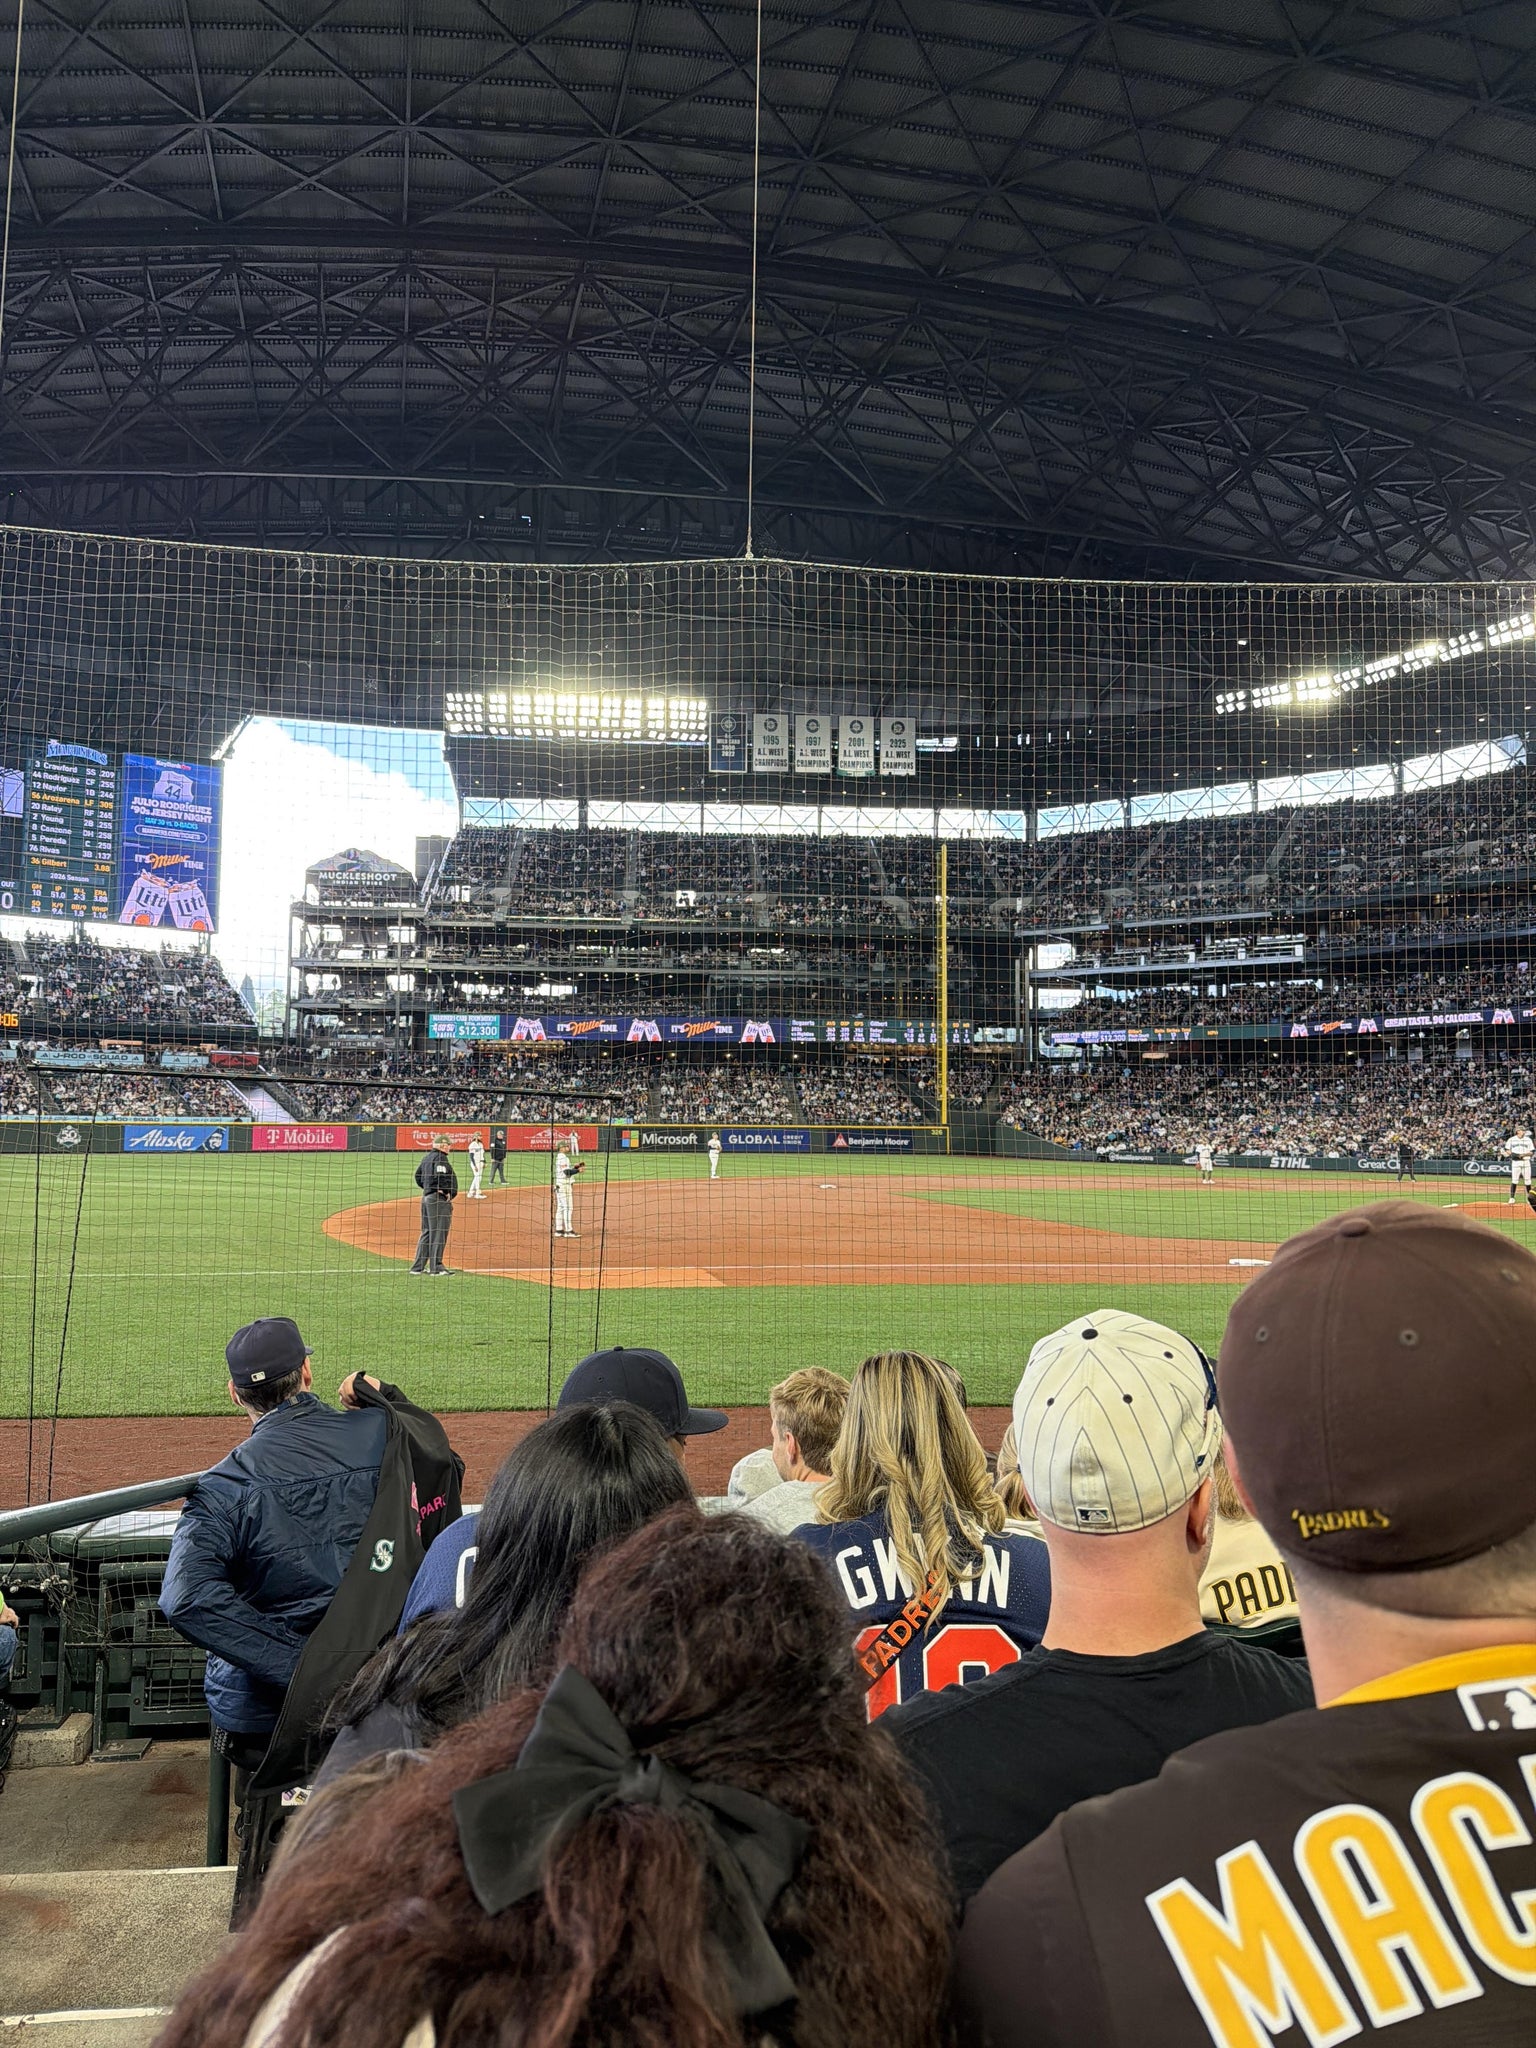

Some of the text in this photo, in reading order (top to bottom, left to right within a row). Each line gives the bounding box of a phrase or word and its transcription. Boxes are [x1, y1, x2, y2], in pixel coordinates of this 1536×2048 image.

[763, 735, 780, 745] 1995
[806, 736, 821, 746] 1997
[848, 738, 864, 747] 2001
[46, 744, 108, 766] MARINERS
[768, 748, 784, 756] WEST
[810, 749, 826, 757] WEST
[854, 750, 870, 758] WEST
[896, 750, 910, 758] WEST
[755, 758, 788, 767] CHAMPIONS
[796, 760, 830, 768] CHAMPIONS
[840, 760, 872, 769] CHAMPIONS
[882, 762, 914, 770] CHAMPIONS
[43, 762, 78, 773] Crawford
[86, 768, 96, 776] SS
[42, 782, 67, 792] Naylor
[86, 778, 95, 786] CF
[164, 786, 181, 799] 44
[42, 794, 80, 805] Arozarena
[42, 804, 63, 813] Raley
[132, 796, 212, 815] JULIO RODRÍGUEZ
[41, 814, 64, 824] Young
[150, 808, 184, 820] JERSEY
[184, 813, 213, 823] NIGHT
[40, 825, 72, 835] Canzone
[40, 835, 67, 845] Pereda
[40, 846, 60, 854] Rivas
[31, 857, 40, 865] 36
[42, 858, 67, 867] Gilbert
[134, 854, 151, 863] IT'S
[147, 853, 191, 870] Miller
[319, 872, 398, 882] MUCKLESHOOT
[2, 892, 13, 909] 0
[136, 887, 168, 908] Lite
[177, 895, 205, 916] Lite
[1384, 1018, 1406, 1027] GREAT
[1433, 1015, 1444, 1024] 96
[459, 1026, 497, 1036] $12,300
[557, 1024, 570, 1032] IT'S
[569, 1020, 606, 1036] Miller
[671, 1025, 685, 1033] IT'S
[684, 1021, 721, 1038] Miller
[129, 1129, 195, 1148] Alaska
[283, 1129, 335, 1144] Mobile
[412, 1130, 429, 1139] fire
[642, 1133, 698, 1145] Microsoft
[729, 1134, 780, 1144] GLOBAL
[849, 1138, 909, 1147] Benjamin Moore
[1270, 1157, 1310, 1169] STIHL
[1358, 1159, 1386, 1169] Great
[1291, 1509, 1390, 1538] PADRES
[370, 1538, 395, 1573] S
[1145, 1753, 1536, 2048] MAC
